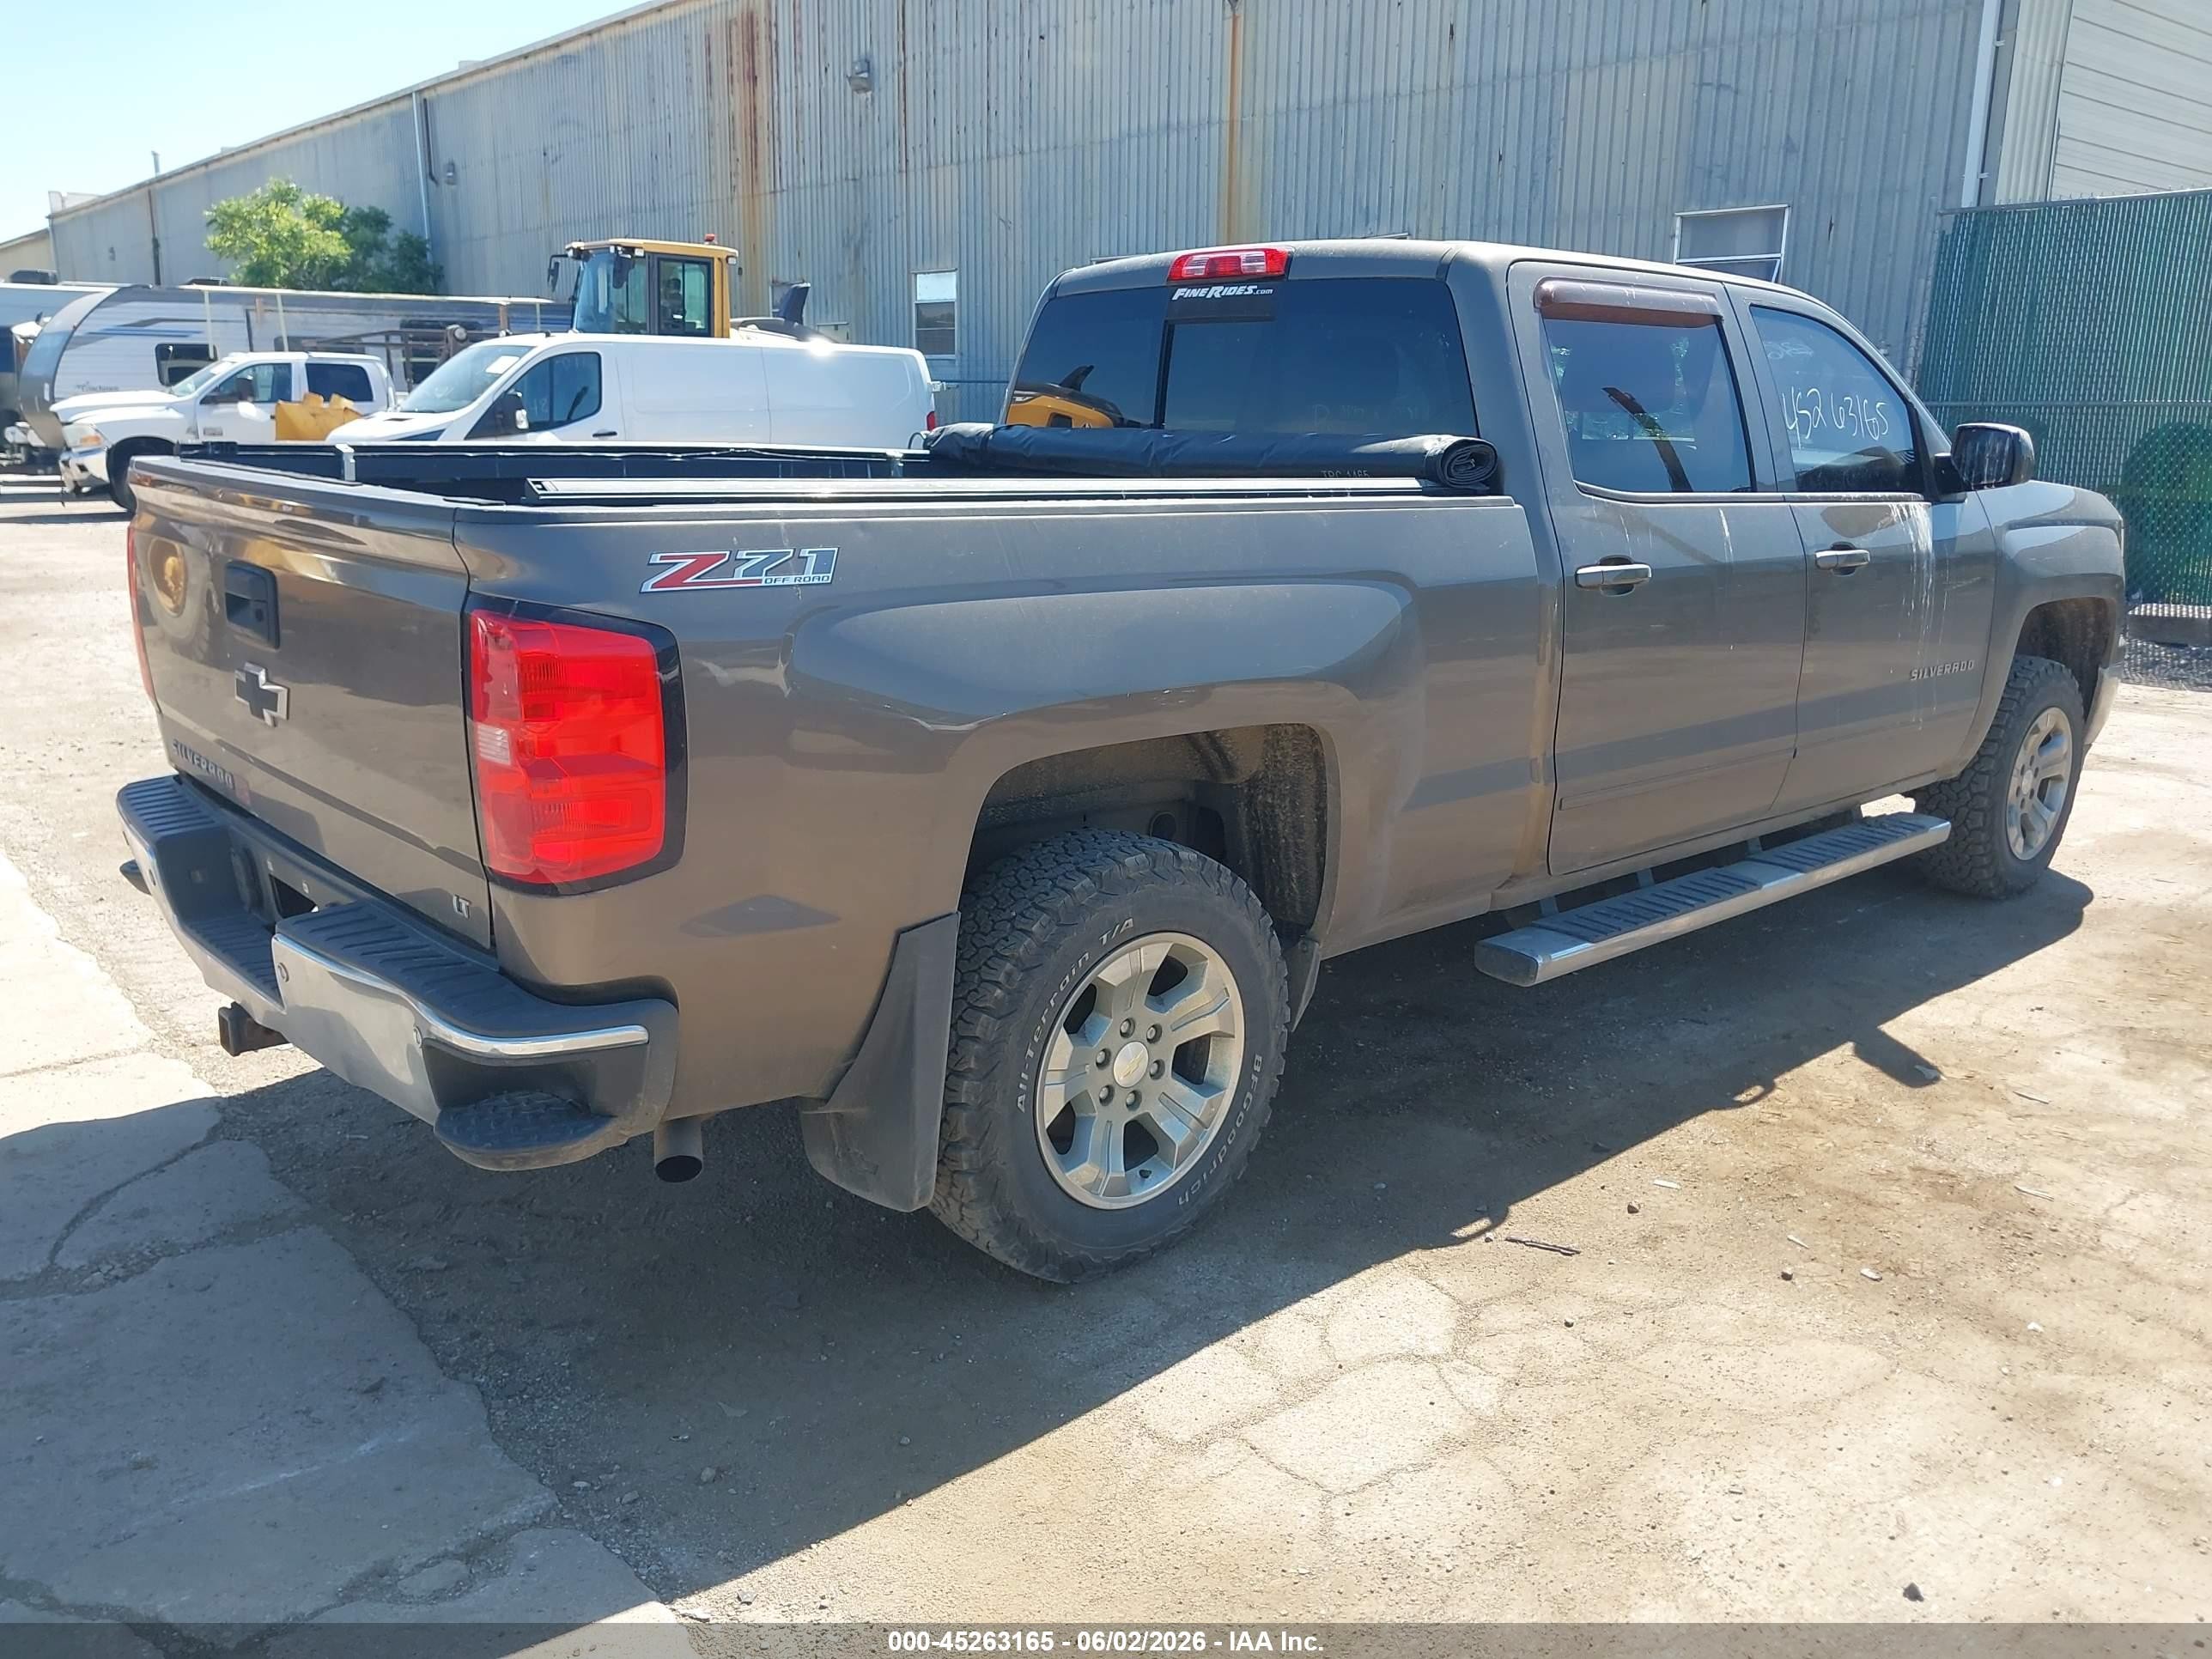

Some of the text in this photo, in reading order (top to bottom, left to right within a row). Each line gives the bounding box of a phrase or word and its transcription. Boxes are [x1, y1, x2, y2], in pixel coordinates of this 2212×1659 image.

[640, 547, 840, 593] Z71
[764, 574, 830, 585] OFF ROAD
[1909, 659, 1975, 681] SILVERADO
[453, 894, 471, 919] LT
[1098, 917, 1134, 945] T/A
